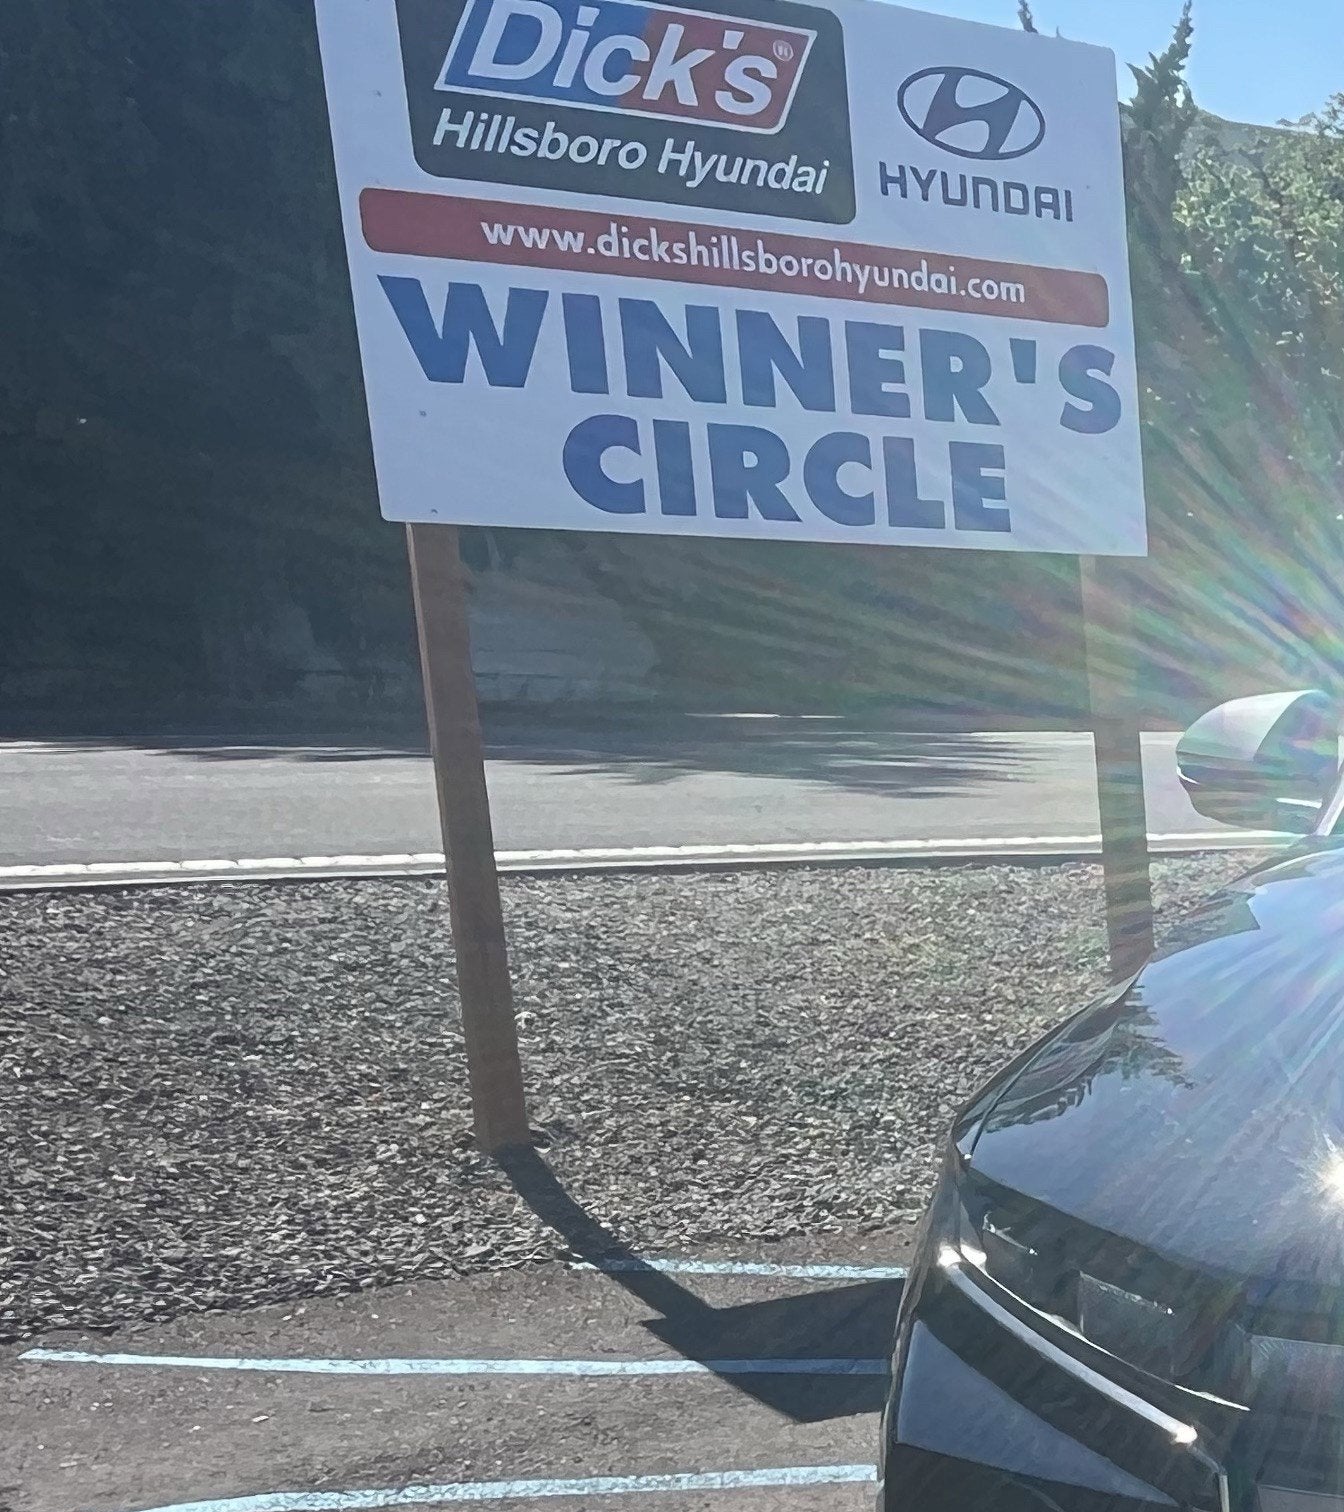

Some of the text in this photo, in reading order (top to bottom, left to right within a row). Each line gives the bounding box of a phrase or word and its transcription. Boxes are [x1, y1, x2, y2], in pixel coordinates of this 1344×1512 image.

[467, 0, 779, 117] Dick's
[432, 107, 830, 196] Hillsboro Hyundai
[878, 161, 1074, 223] HYUNDAI
[480, 216, 1026, 305] www.dickshillsborohyundai.com
[375, 274, 1123, 435] WINNER'S
[561, 412, 1013, 534] CIRCLE
